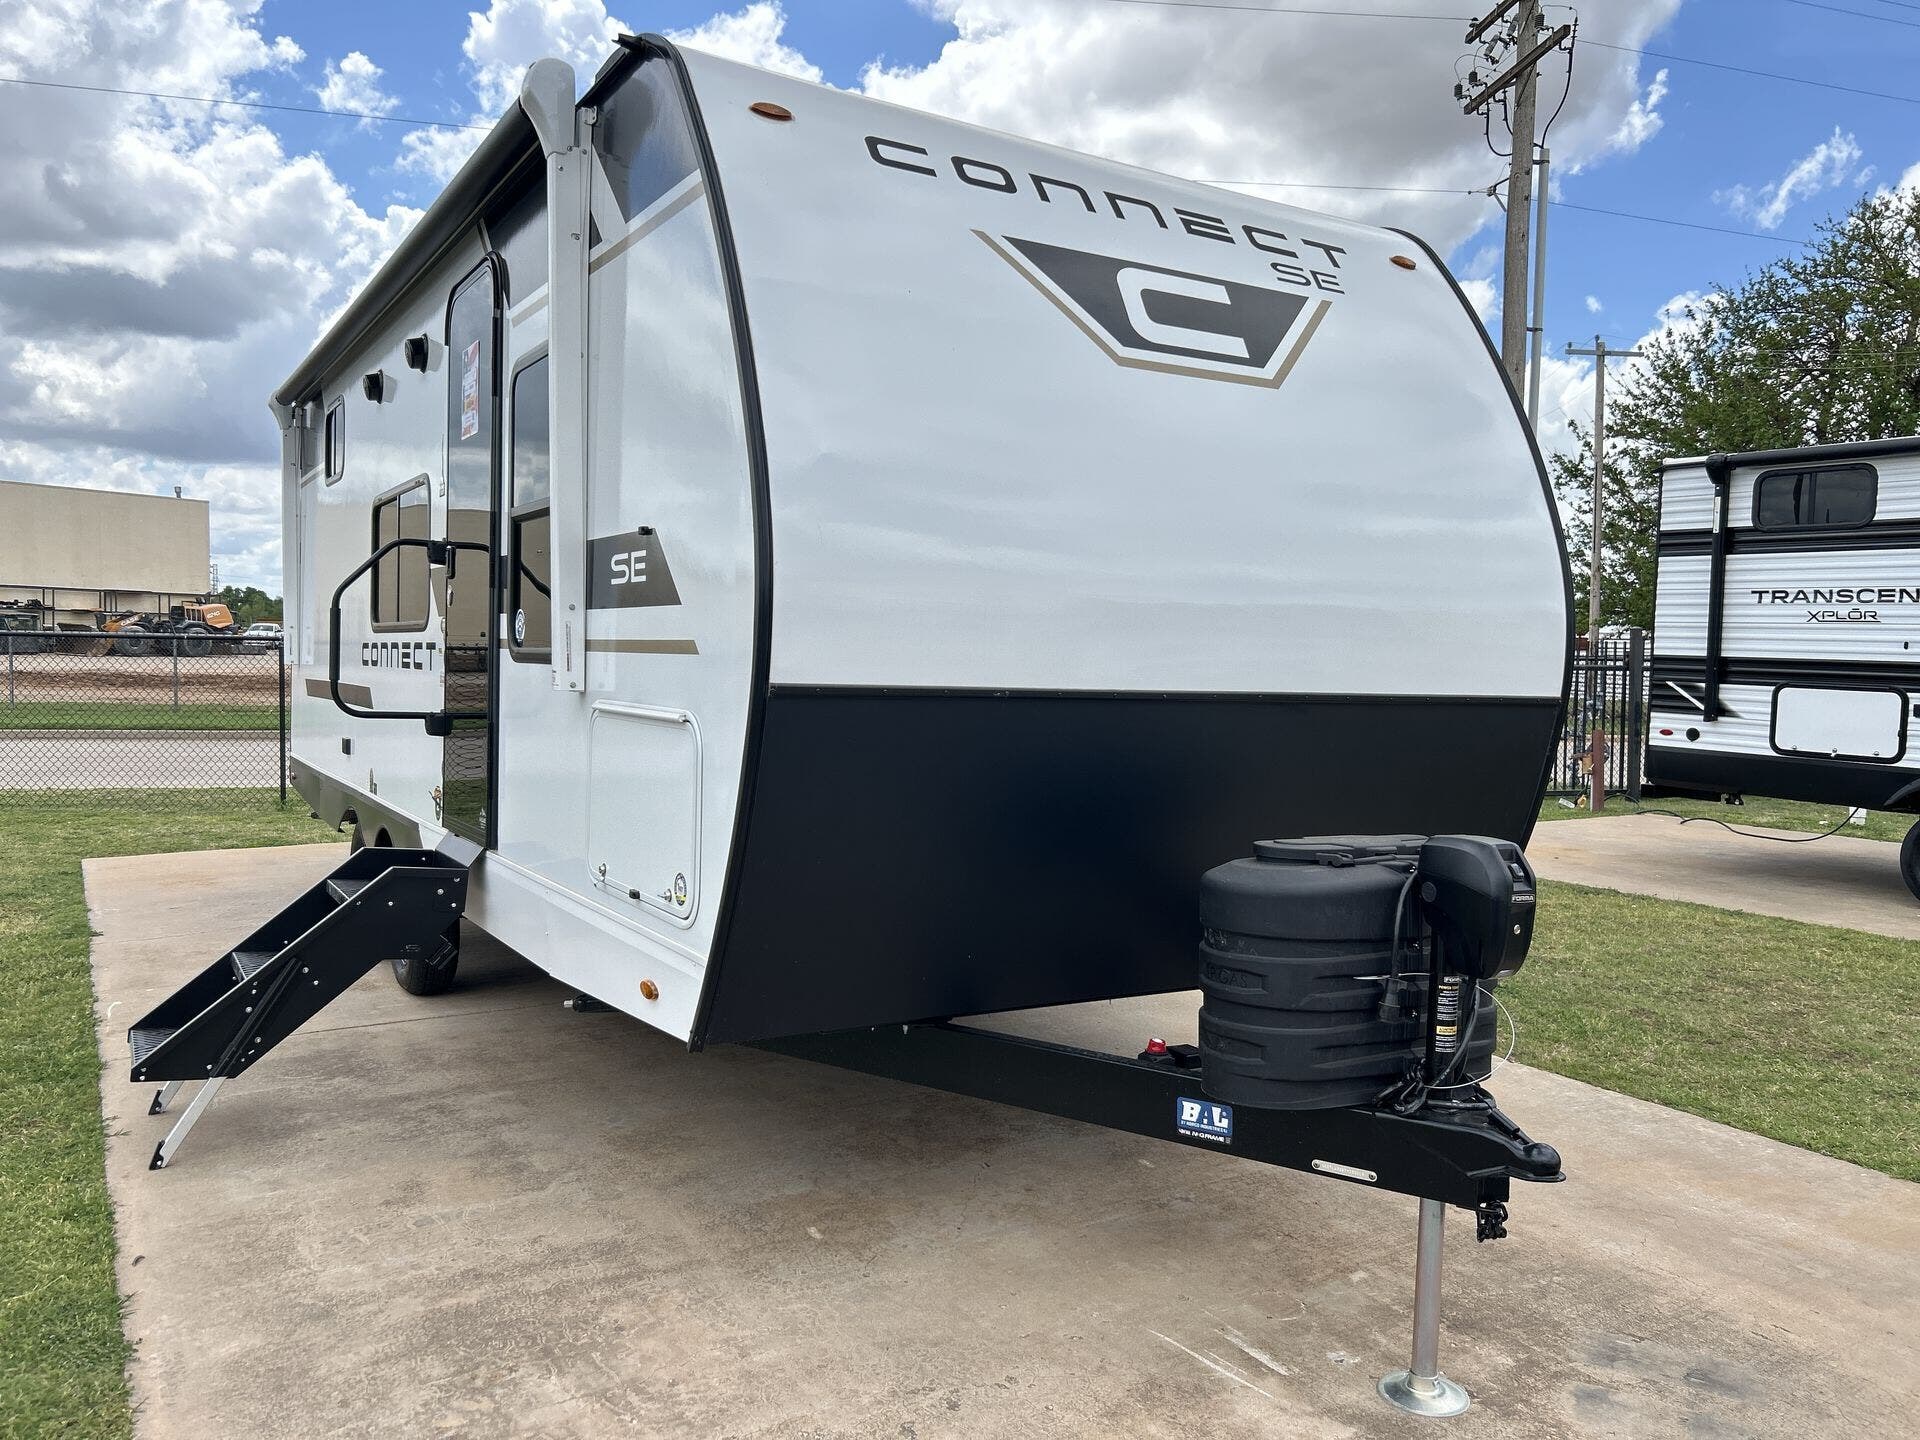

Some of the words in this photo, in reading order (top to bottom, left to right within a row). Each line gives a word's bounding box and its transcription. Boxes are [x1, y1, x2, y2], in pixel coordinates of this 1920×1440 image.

[864, 135, 1348, 269] CONNECT
[1269, 261, 1346, 295] SE
[610, 549, 647, 585] SE
[1750, 588, 1920, 604] TRANSCEN
[361, 641, 437, 672] CONNECT
[1181, 1100, 1229, 1129] BAL
